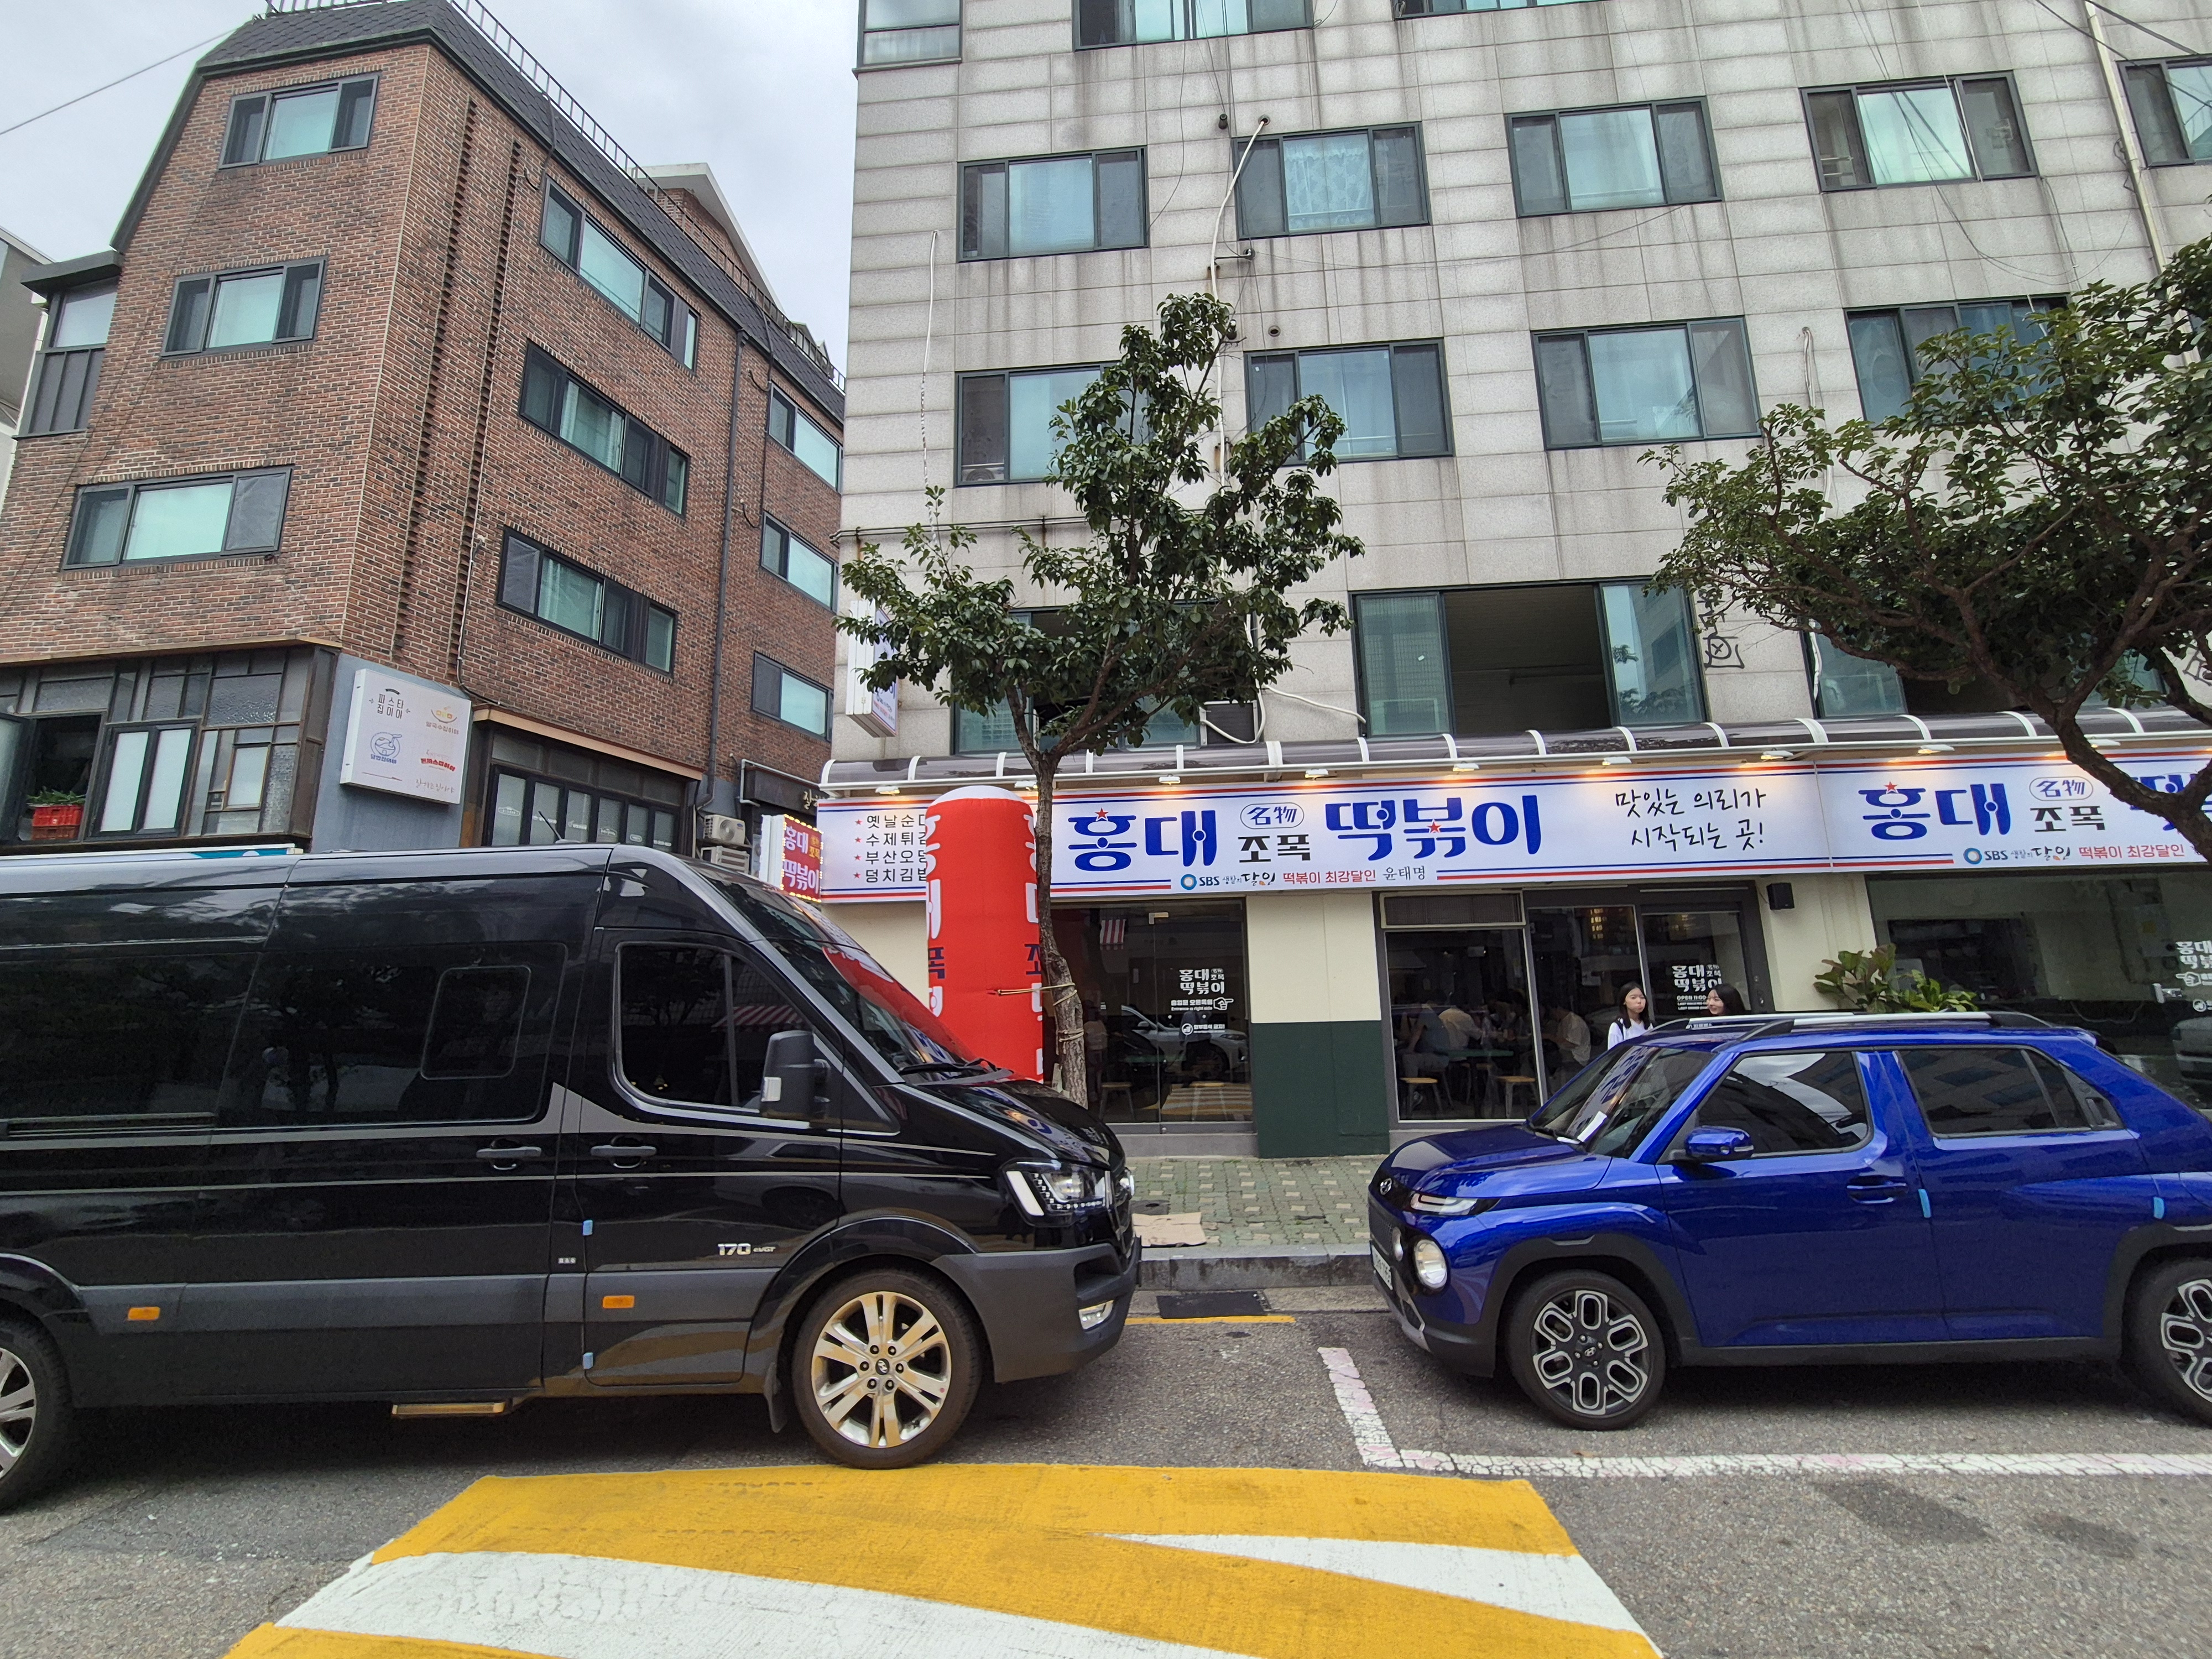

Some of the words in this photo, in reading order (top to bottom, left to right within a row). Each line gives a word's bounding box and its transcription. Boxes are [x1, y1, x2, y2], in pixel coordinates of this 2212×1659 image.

[2036, 780, 2085, 797] 名物
[1616, 787, 1684, 817] 맛있는
[1693, 788, 1766, 810] 의리가
[1858, 783, 2011, 839] 홍대
[1246, 806, 1297, 824] 名物
[2030, 805, 2105, 833] 조폭
[1325, 795, 1542, 860] 떡볶이
[1631, 822, 1726, 852] 시작되는
[1735, 820, 1763, 851] 곳!
[785, 826, 808, 854] 홍대
[1068, 807, 1217, 872] 홍대
[1238, 834, 1311, 863] 조폭
[1985, 851, 2008, 860] SBS
[2079, 846, 2122, 859] 떡볶이
[2127, 844, 2185, 858] 최강달인
[784, 859, 820, 894] 떡볶이
[1199, 876, 1220, 886] SBS
[1283, 872, 1321, 884] 떡볶이
[1325, 870, 1376, 883] 최강달인
[1383, 865, 1426, 881] 윤태명
[2176, 940, 2212, 954] 홍대
[1179, 969, 1209, 982] 홍대
[1672, 964, 1704, 978] 홍대
[1180, 981, 1225, 995] 떡볶이
[718, 1243, 751, 1255] 170
